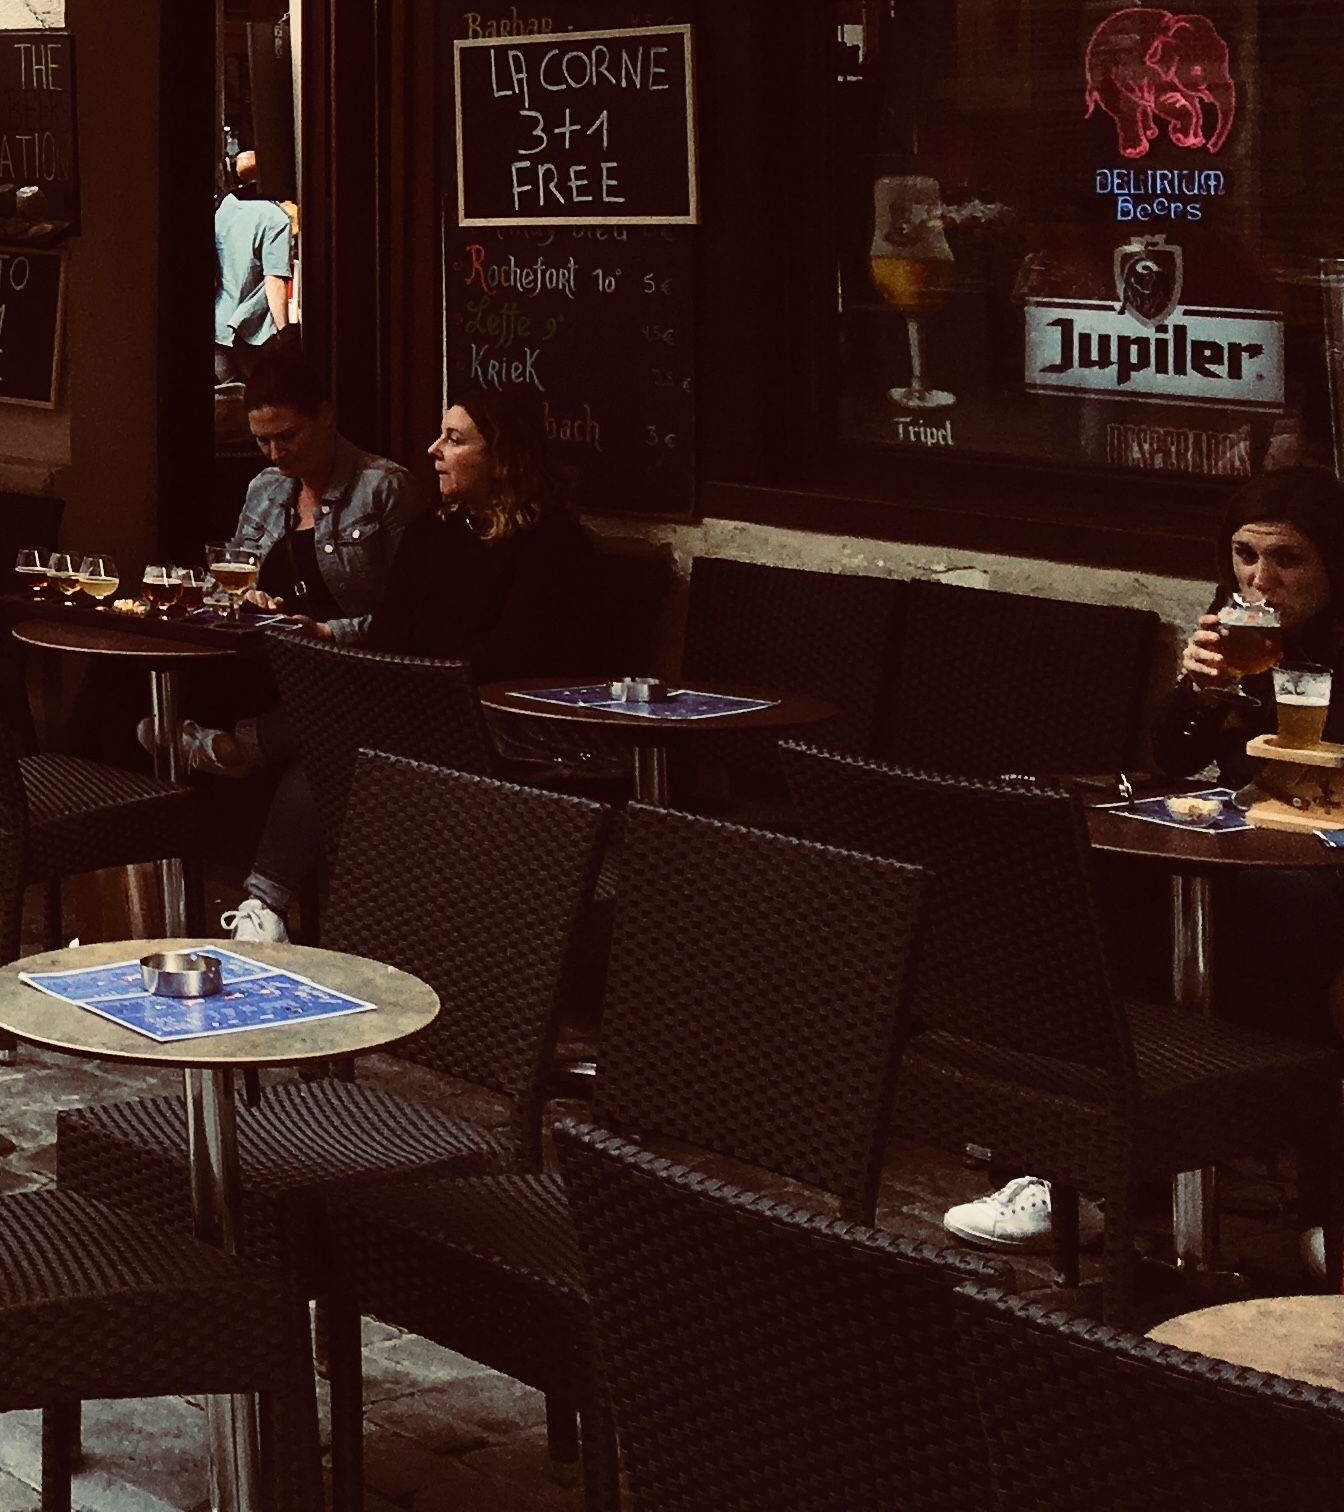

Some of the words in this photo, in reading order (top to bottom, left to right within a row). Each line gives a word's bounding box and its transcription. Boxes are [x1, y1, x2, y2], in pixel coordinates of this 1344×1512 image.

[13, 43, 63, 91] THE
[489, 48, 530, 110] LA
[539, 44, 670, 91] CORNE
[517, 107, 609, 155] 3+1
[511, 160, 627, 211] FREE
[1094, 168, 1226, 196] DELIRIUM
[1115, 197, 1203, 223] Beers
[1038, 317, 1264, 387] Jupiler
[892, 416, 955, 447] Tripel
